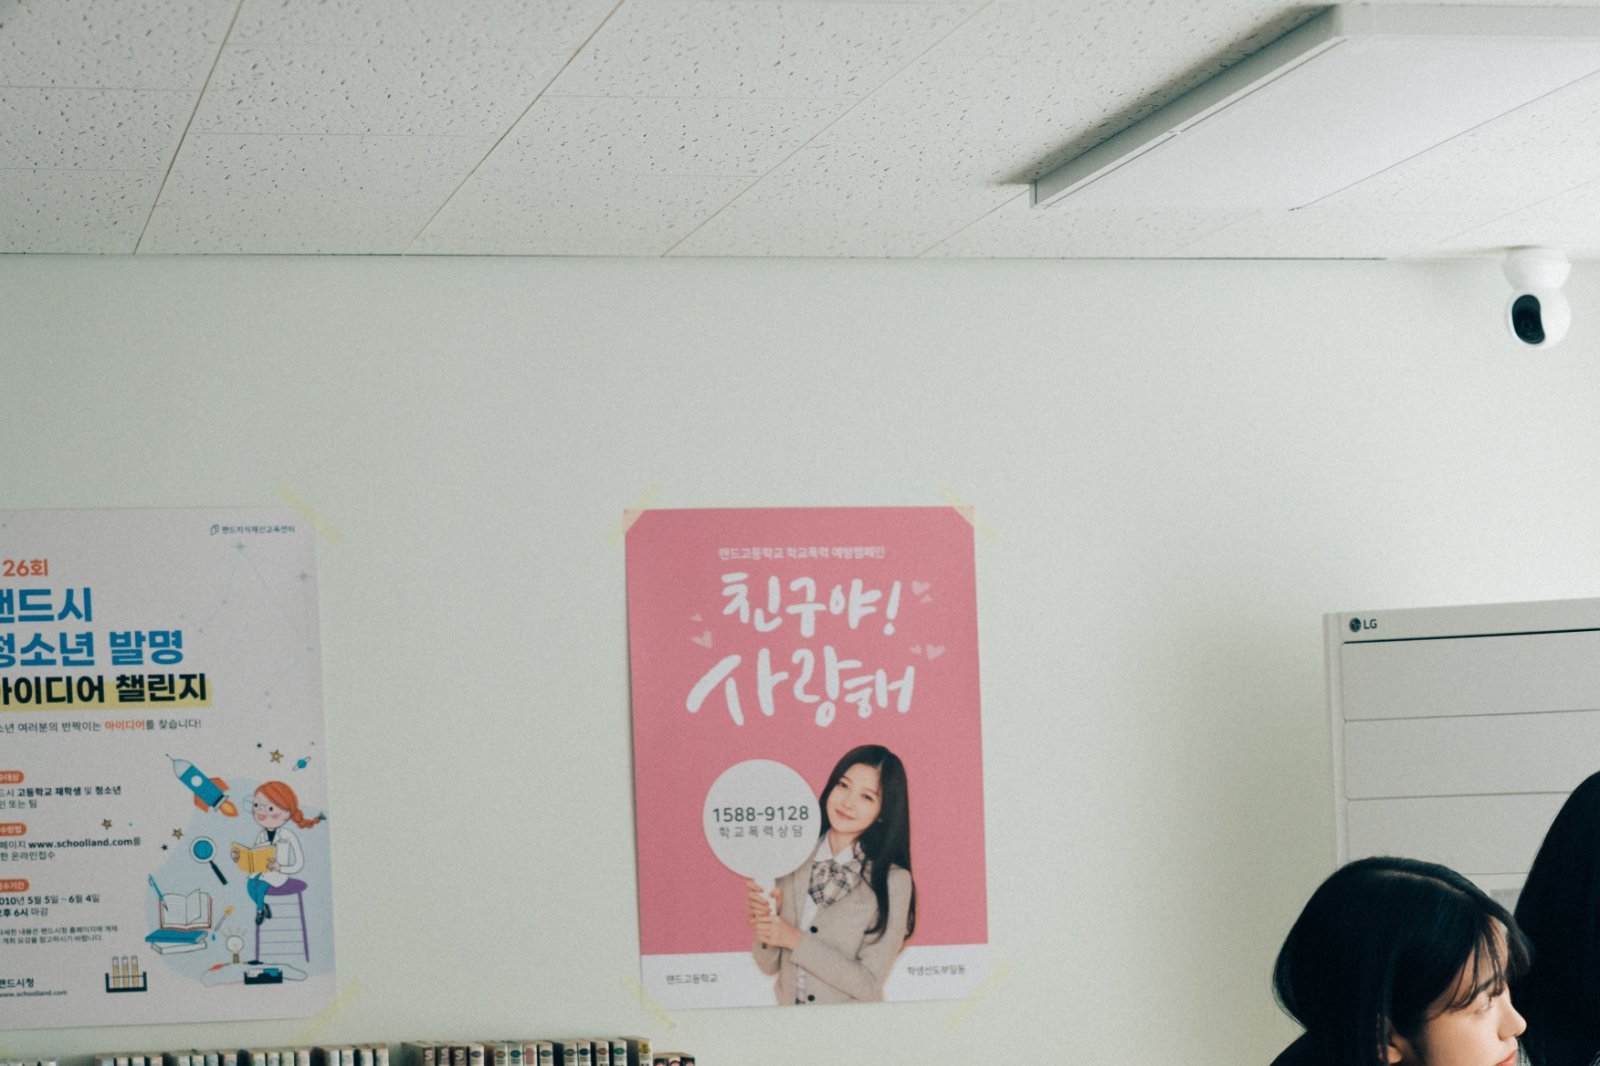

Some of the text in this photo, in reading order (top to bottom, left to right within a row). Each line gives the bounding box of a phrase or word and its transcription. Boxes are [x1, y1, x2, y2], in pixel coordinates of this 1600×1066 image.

[2, 558, 49, 577] 26회
[721, 572, 901, 638] 친구야!
[1364, 618, 1378, 630] LG
[109, 630, 184, 666] 발명
[116, 673, 207, 703] 챌린지
[686, 644, 916, 728] 사랑해
[18, 721, 58, 733] 여러분의
[61, 720, 100, 732] 반짝이는
[104, 719, 154, 732] 아이디어를
[158, 718, 201, 730] 찾습니다!
[18, 787, 52, 798] 고등학교
[55, 786, 82, 796] 재학생
[95, 786, 122, 796] 청소년
[9, 800, 26, 809] 또는
[28, 799, 38, 808] 팀
[712, 806, 809, 822] 1588-9128
[28, 896, 42, 905] 5월
[44, 895, 58, 904] 5일
[68, 894, 82, 904] 6월
[85, 894, 100, 904] 4일
[14, 908, 28, 918] 6시
[30, 907, 48, 917] 마감
